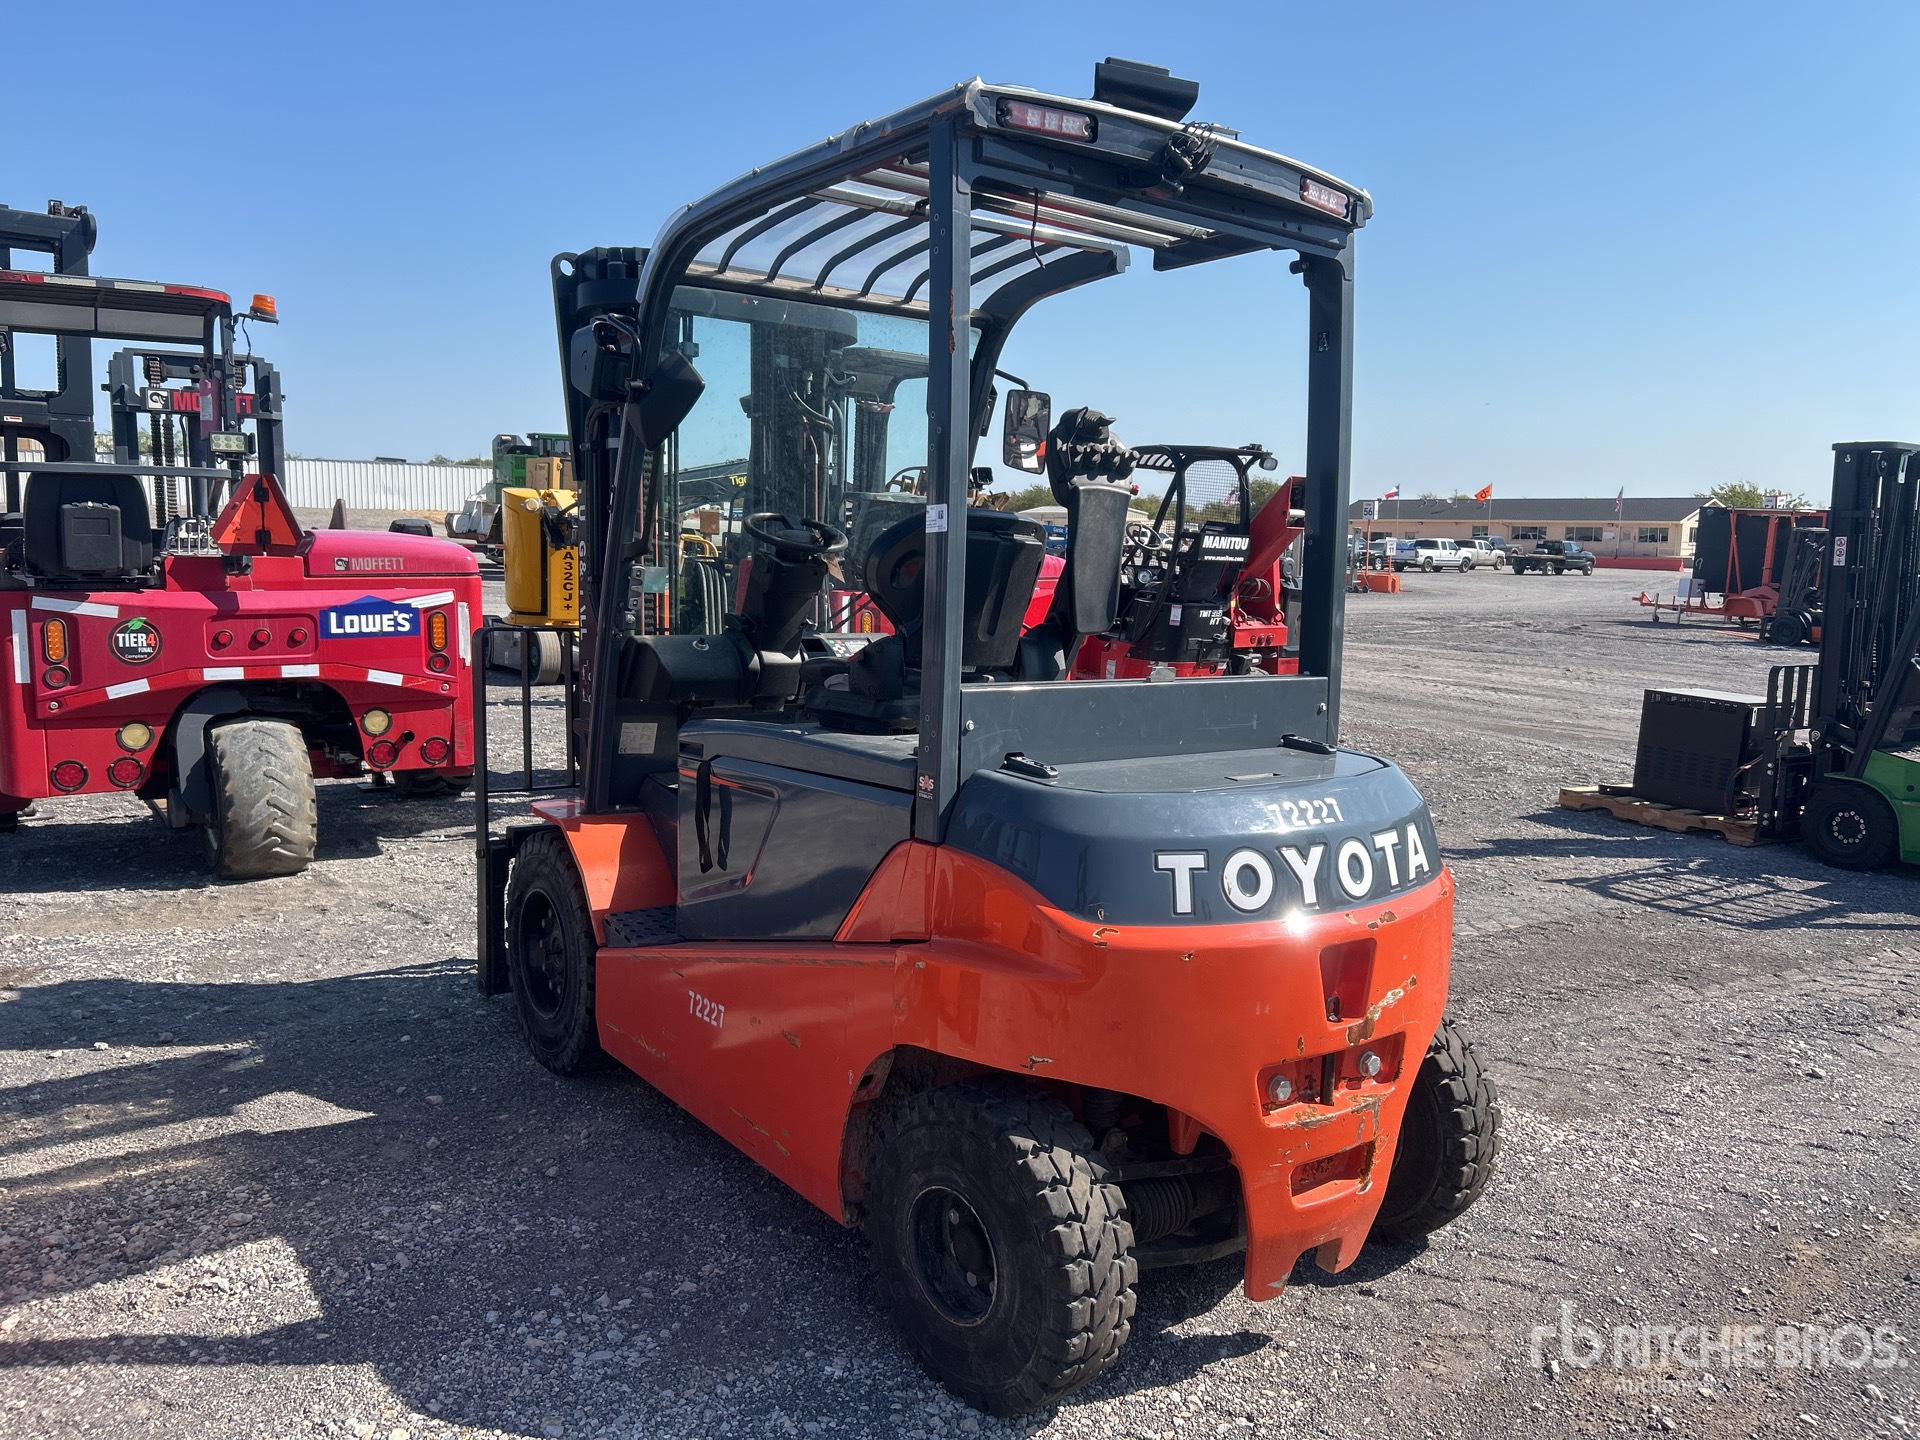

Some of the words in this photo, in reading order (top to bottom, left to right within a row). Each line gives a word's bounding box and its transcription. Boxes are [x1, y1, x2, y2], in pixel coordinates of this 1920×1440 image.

[172, 391, 254, 414] MOTT
[1202, 535, 1250, 550] MANITOU
[351, 557, 405, 571] MOFFETT
[562, 545, 575, 611] A32CJ+
[329, 610, 411, 634] LOWE'S
[1156, 822, 1432, 915] TOYOTA
